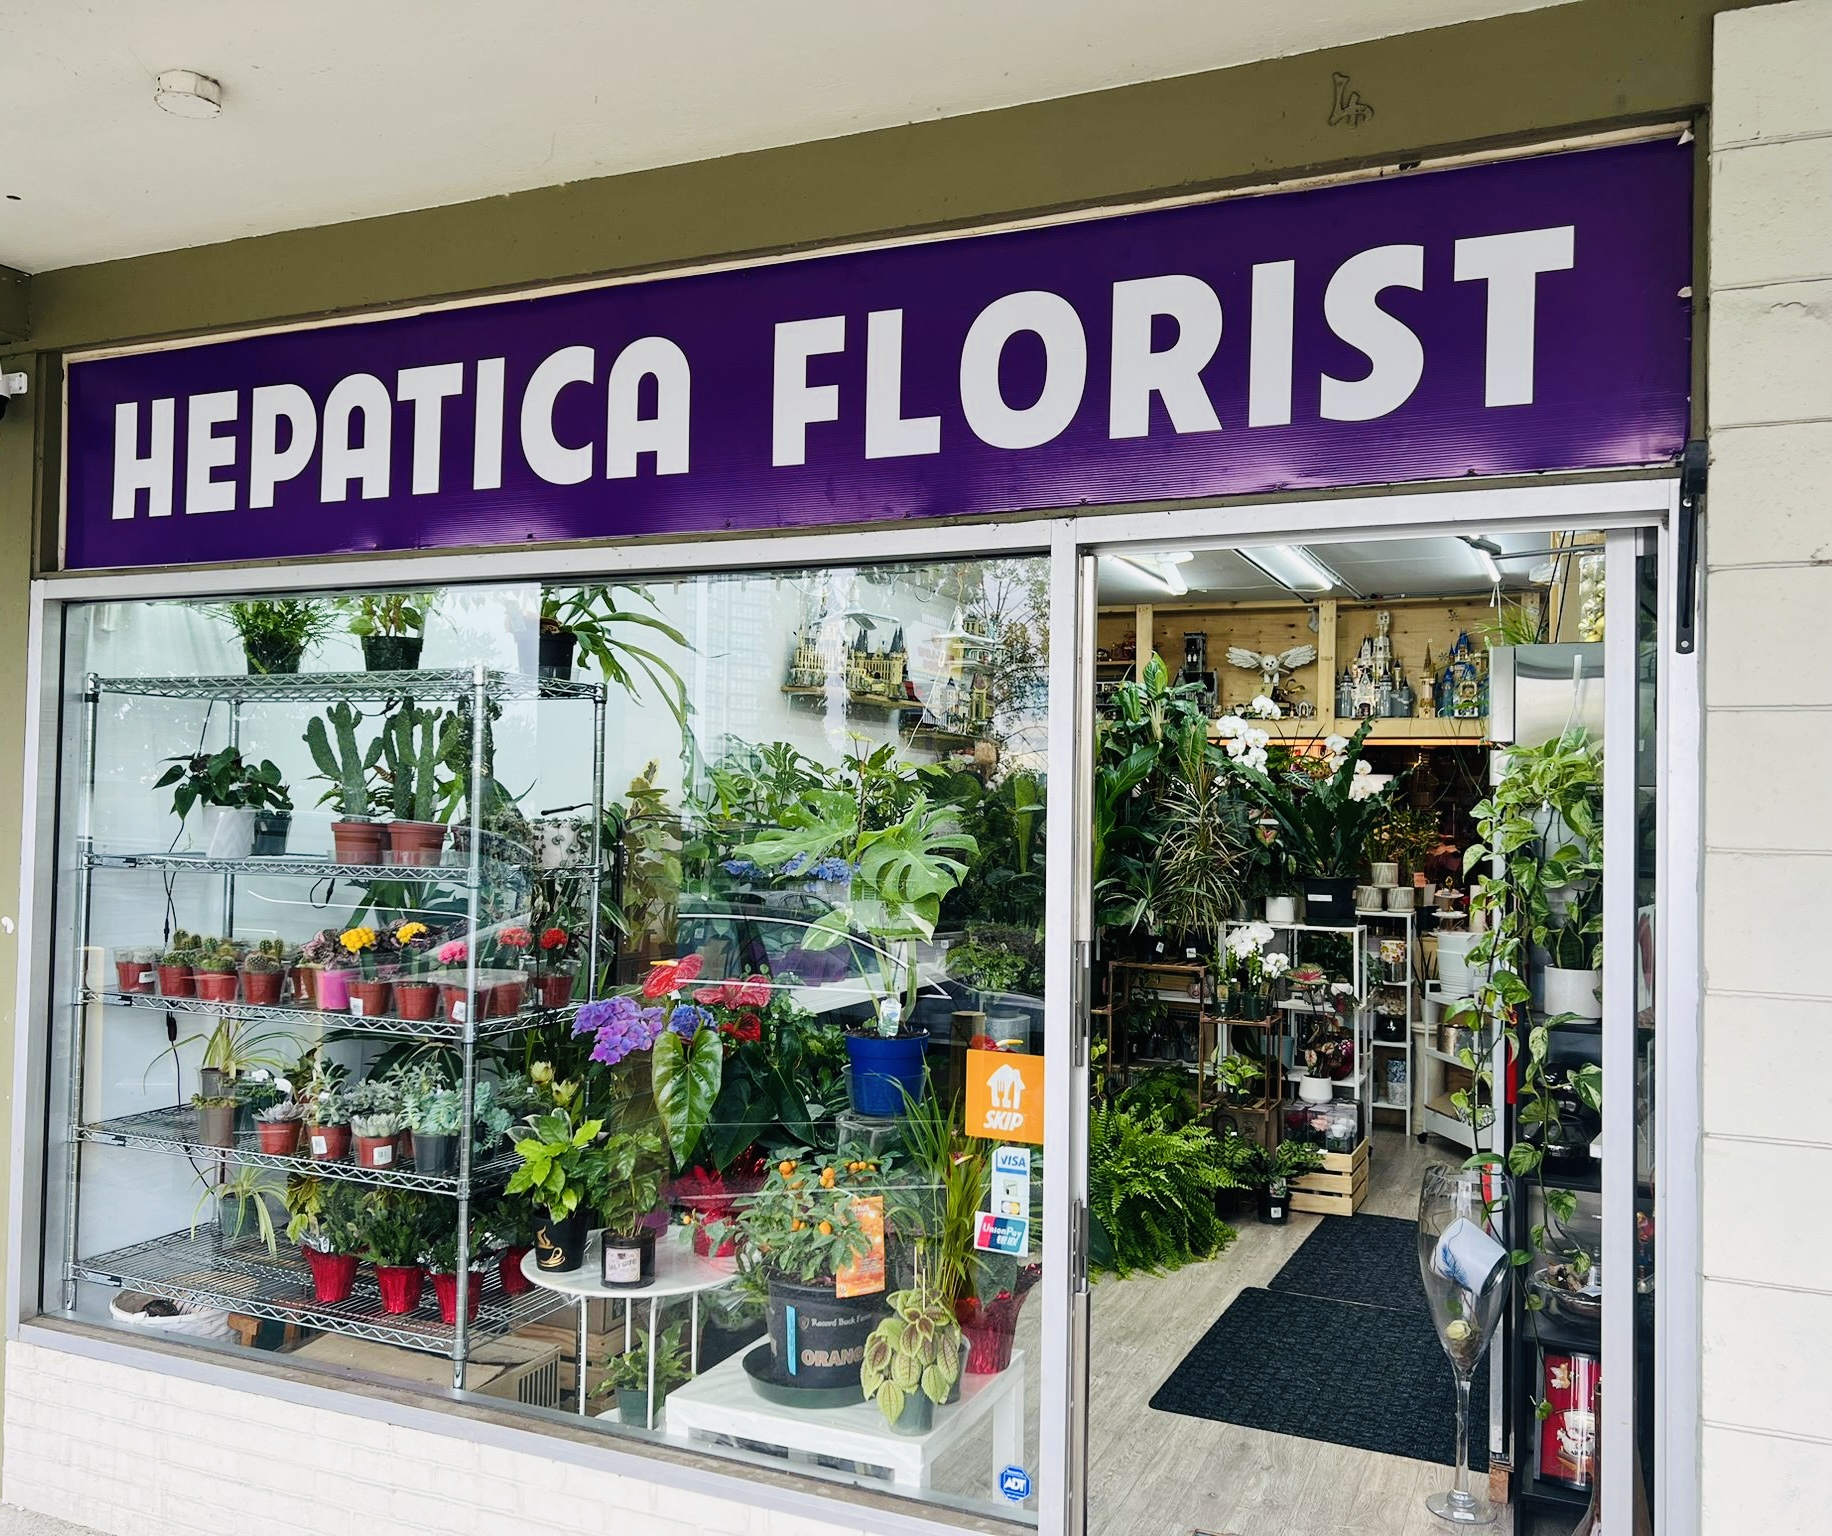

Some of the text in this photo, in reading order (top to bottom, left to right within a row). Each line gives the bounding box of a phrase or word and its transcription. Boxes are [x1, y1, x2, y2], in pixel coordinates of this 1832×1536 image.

[111, 225, 1576, 520] HEPATICA FLORIST
[983, 1109, 1024, 1131] SKIP
[1001, 1155, 1026, 1167] VISA
[983, 1223, 1022, 1239] UnionPay
[801, 1347, 864, 1367] ORANG
[1004, 1477, 1026, 1492] ADT
